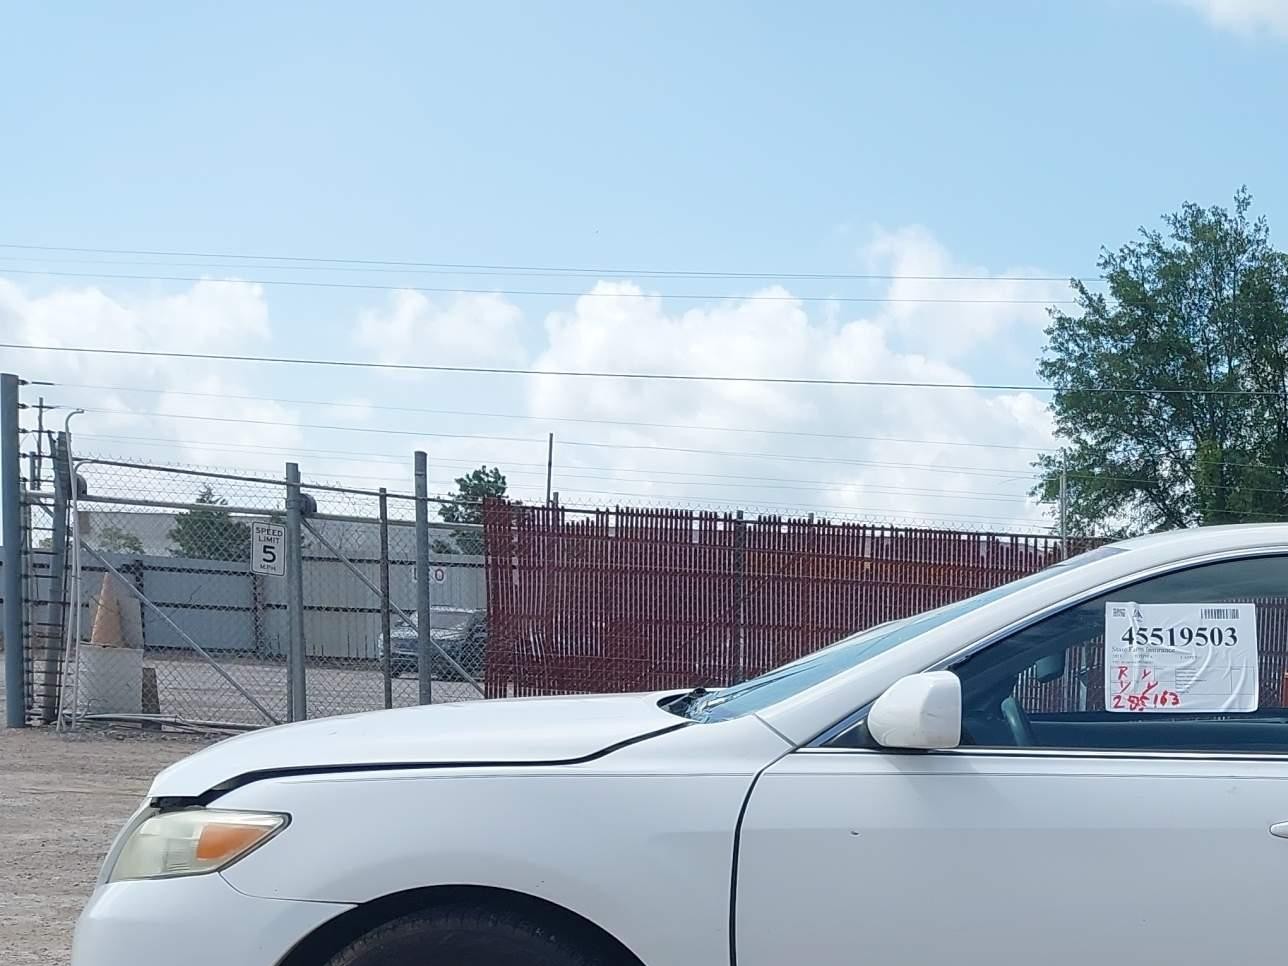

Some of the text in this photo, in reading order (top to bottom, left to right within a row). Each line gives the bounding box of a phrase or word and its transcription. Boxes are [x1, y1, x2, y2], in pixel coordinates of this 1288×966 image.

[255, 526, 283, 537] SPEED
[258, 535, 280, 545] LIMIT
[262, 544, 277, 563] 5
[1121, 626, 1239, 647] 45519503
[1118, 666, 1128, 680] R
